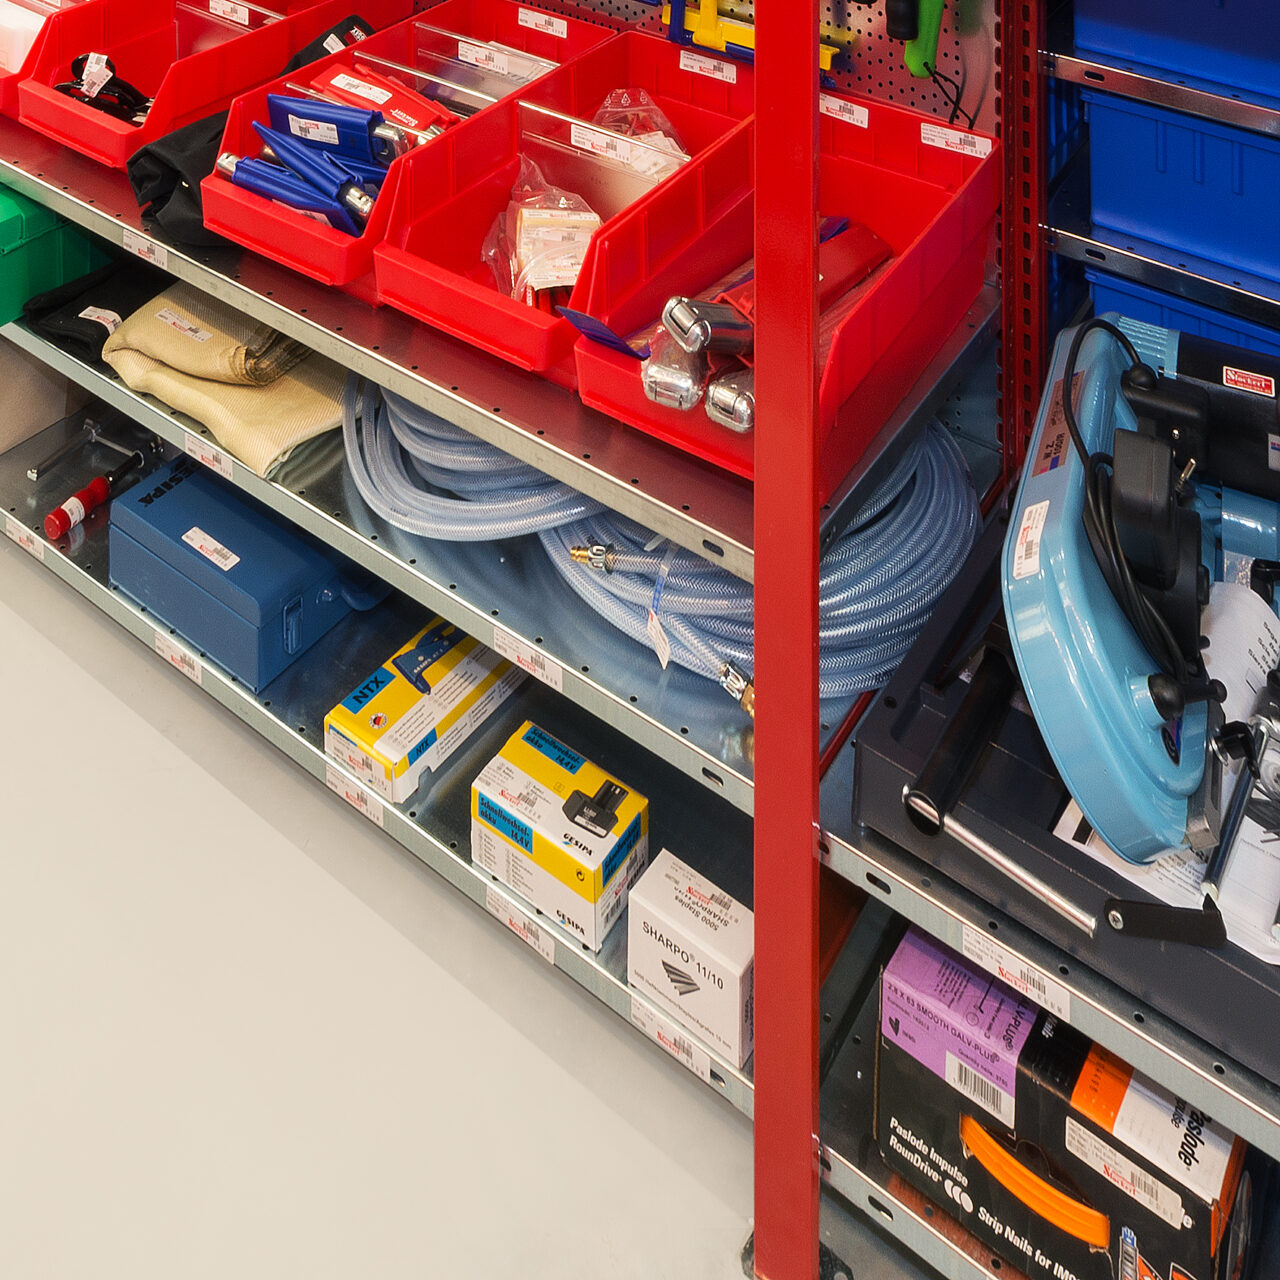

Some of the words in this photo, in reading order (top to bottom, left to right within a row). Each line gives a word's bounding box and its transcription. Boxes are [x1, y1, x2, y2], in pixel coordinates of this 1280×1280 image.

[352, 675, 385, 705] NTX
[416, 739, 430, 756] NTX
[563, 832, 593, 857] GESIPA
[556, 909, 586, 936] GESIPA
[696, 961, 724, 991] 11/10
[906, 995, 915, 1006] 63
[916, 1002, 949, 1031] SMOOTH
[889, 1116, 929, 1156] Paslode
[929, 1147, 969, 1188] Impulse
[978, 1206, 1004, 1235] Strip
[1004, 1224, 1033, 1257] Nails
[1034, 1250, 1053, 1271] for
